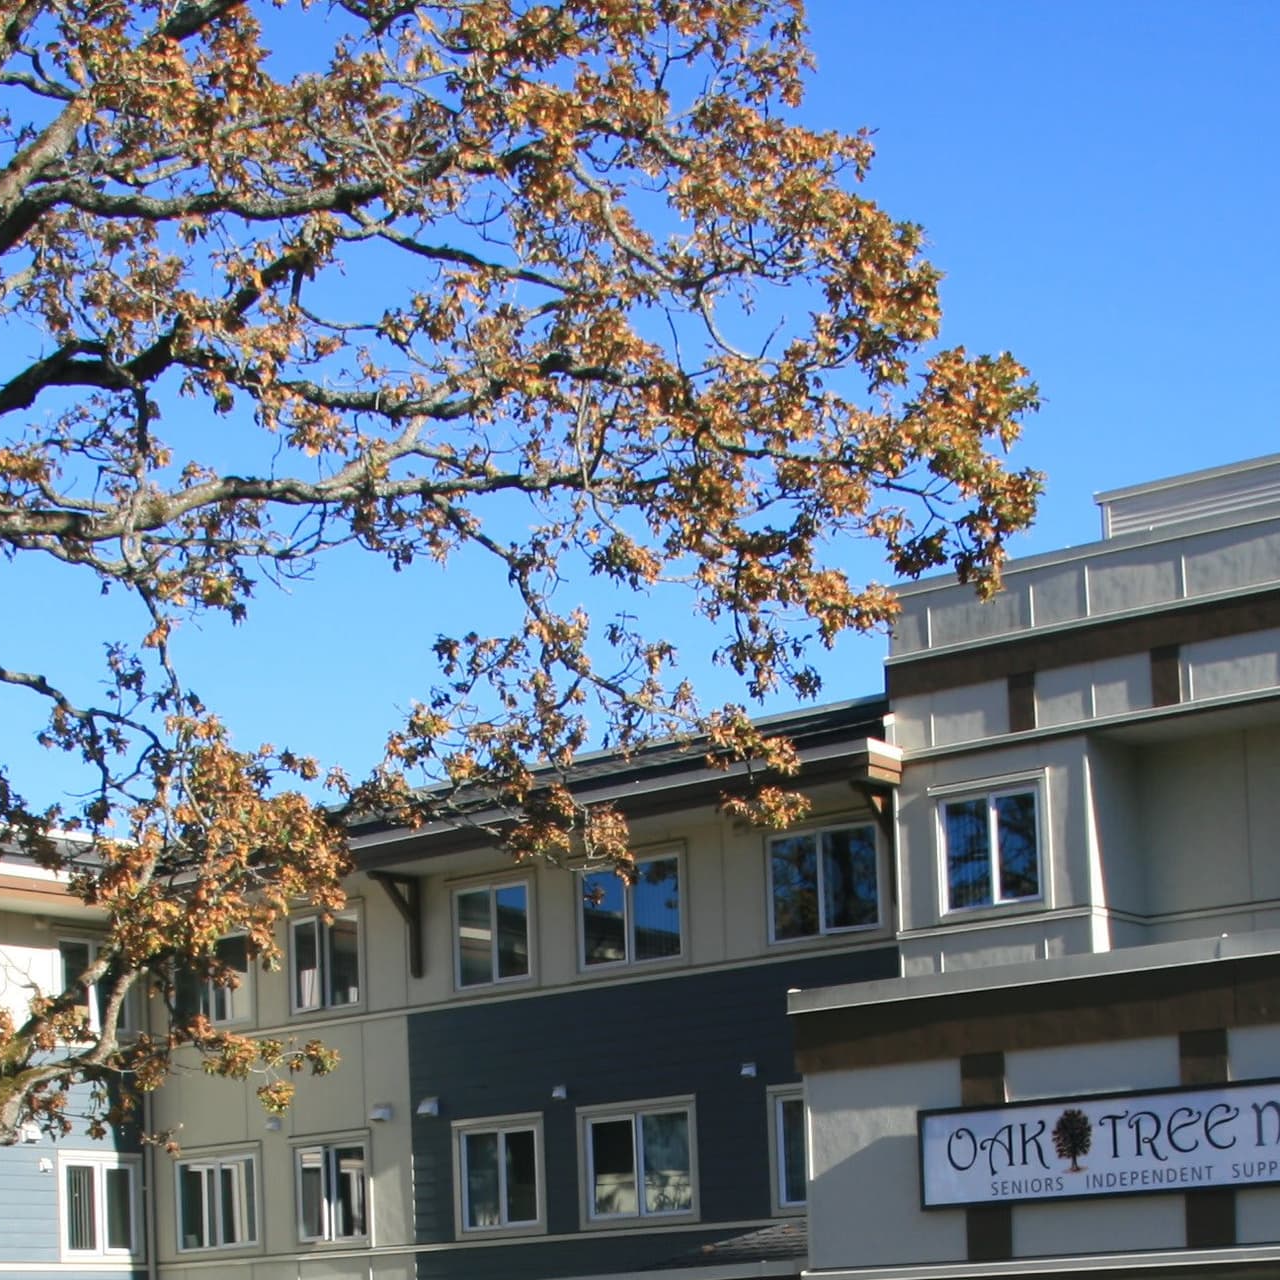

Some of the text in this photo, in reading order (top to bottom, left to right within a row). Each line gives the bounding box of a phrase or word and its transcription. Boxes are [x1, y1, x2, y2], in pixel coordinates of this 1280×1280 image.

[947, 1119, 1050, 1176] OAK
[1099, 1103, 1239, 1162] TREE
[991, 1176, 1065, 1196] SENIORS
[1085, 1165, 1215, 1189] INDEPENDENT
